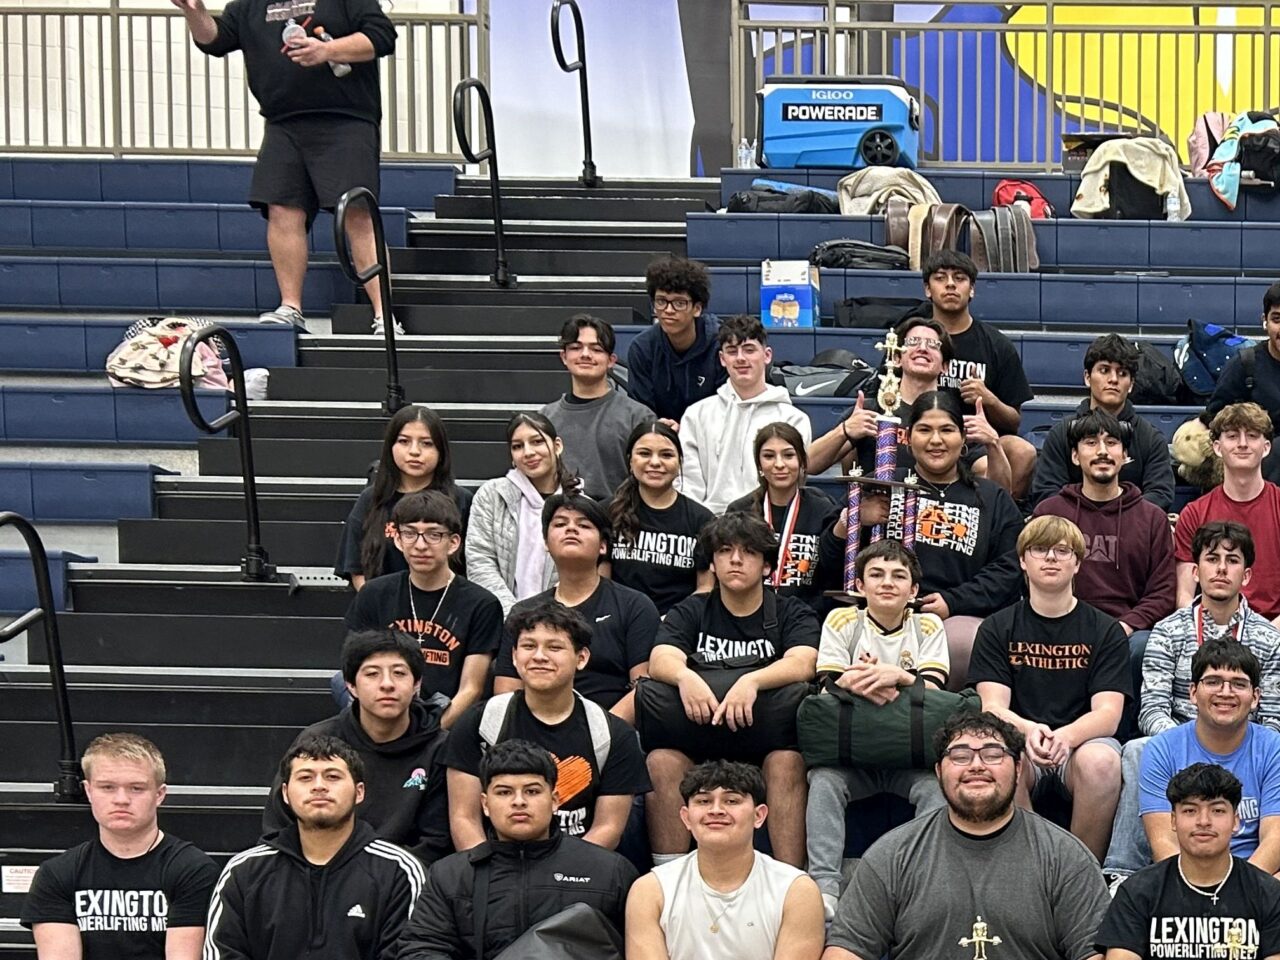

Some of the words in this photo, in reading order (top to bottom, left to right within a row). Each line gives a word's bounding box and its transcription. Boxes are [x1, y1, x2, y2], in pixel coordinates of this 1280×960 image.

[812, 90, 853, 100] IGLOO
[1009, 642, 1092, 656] LEXINGTON
[1023, 655, 1089, 669] ATHLETICS
